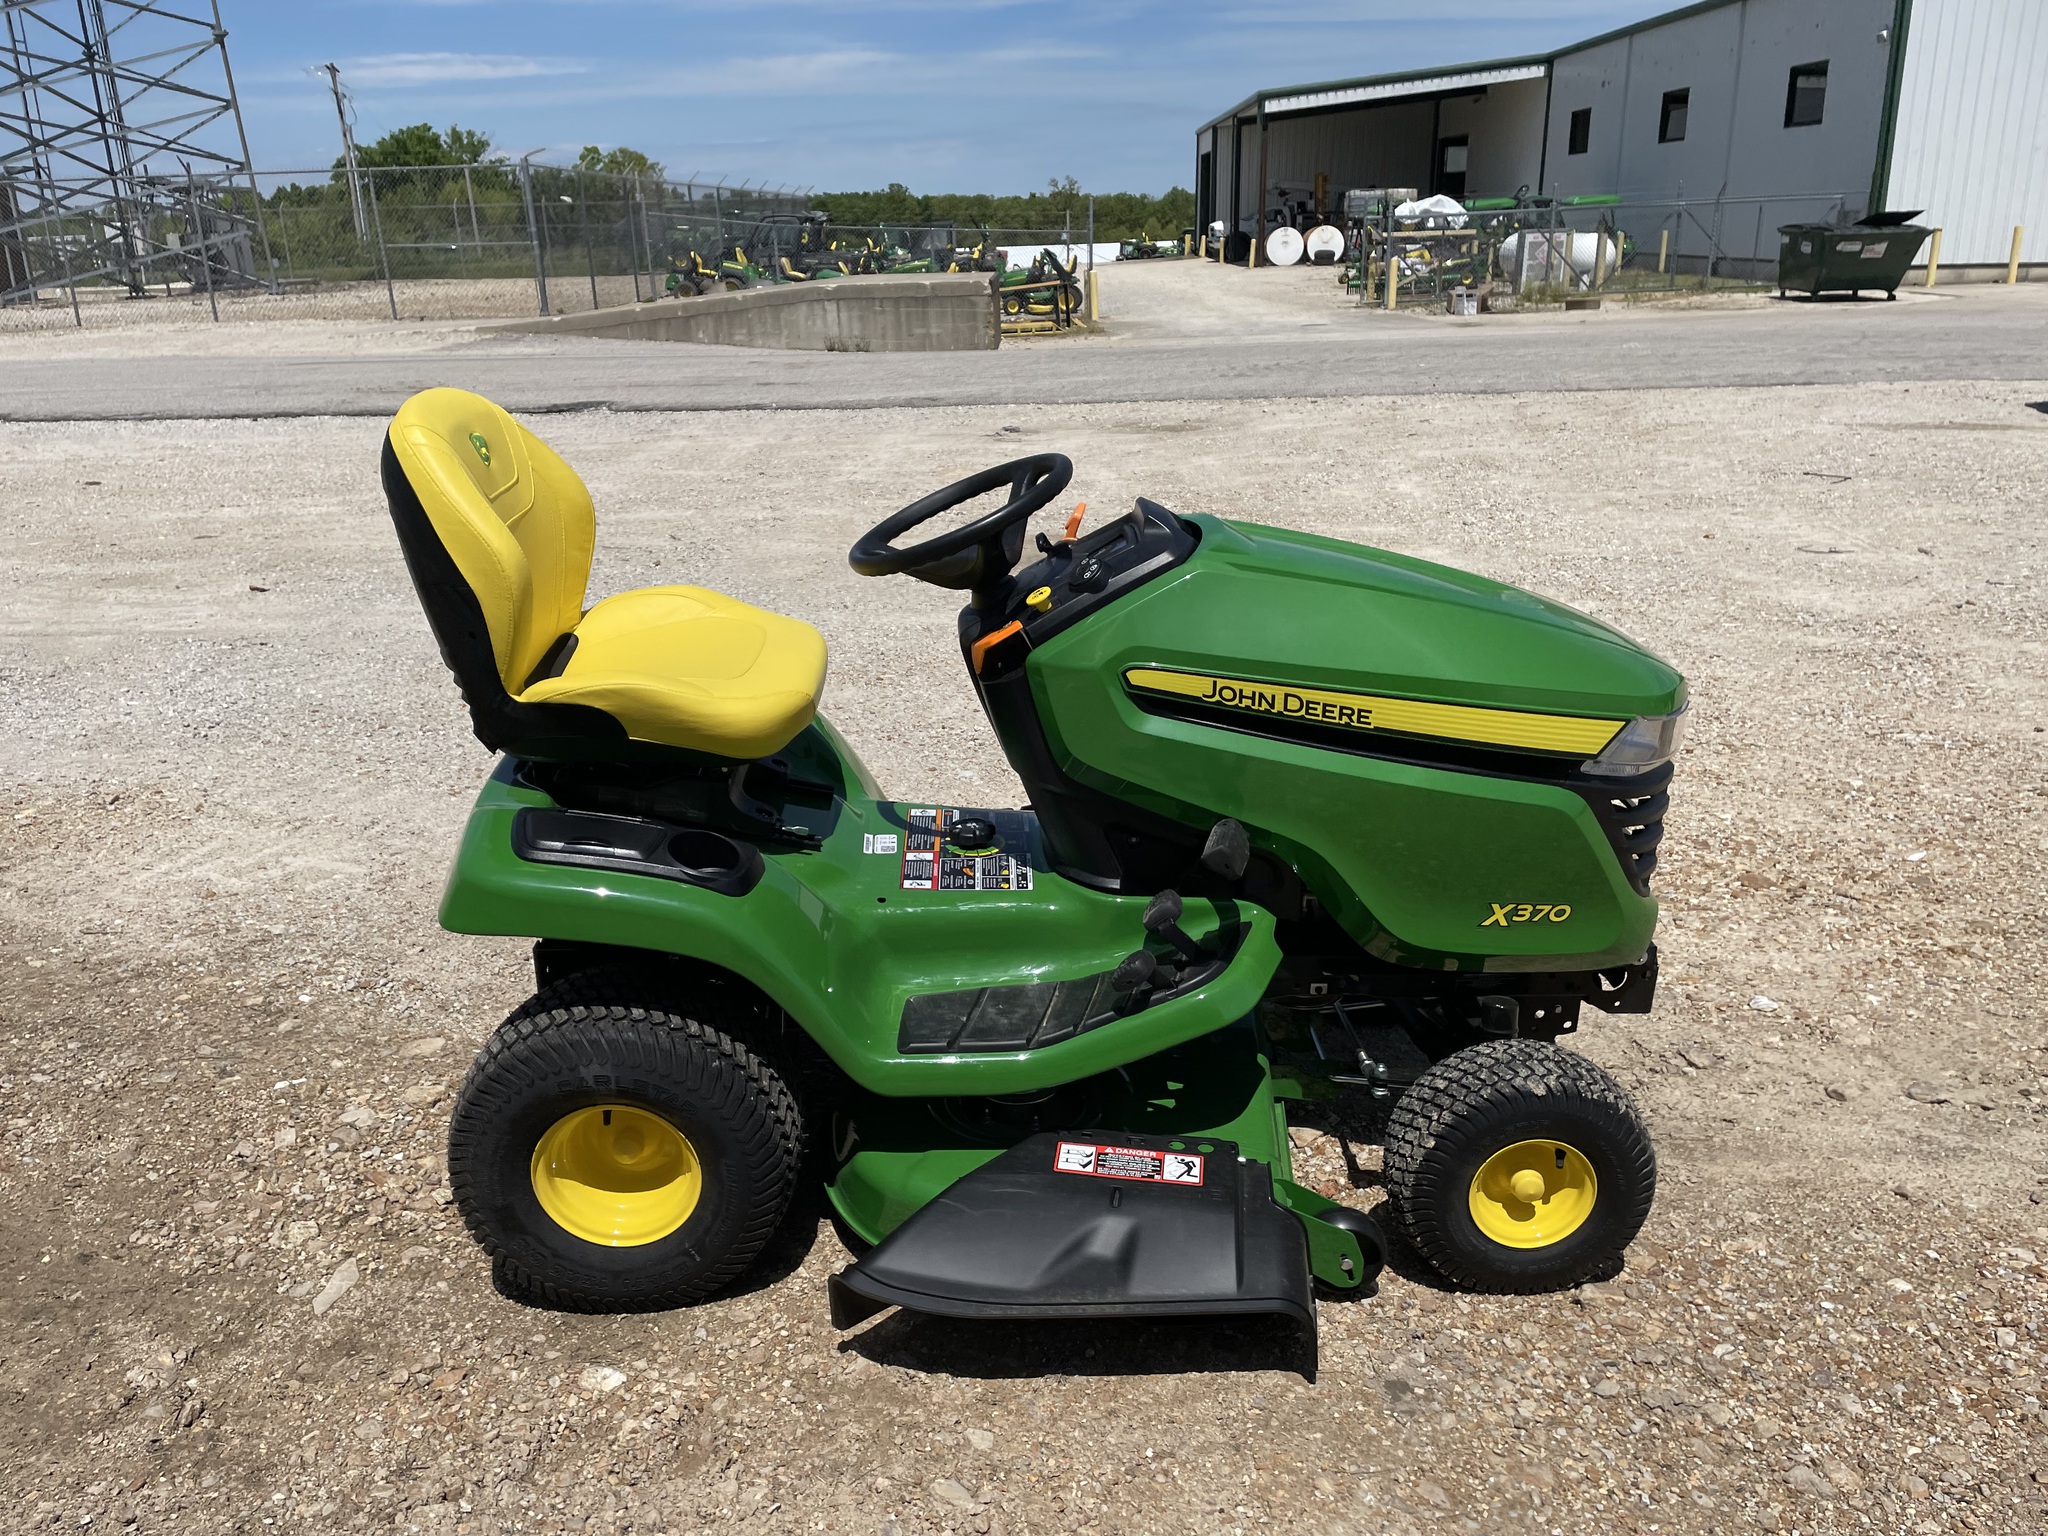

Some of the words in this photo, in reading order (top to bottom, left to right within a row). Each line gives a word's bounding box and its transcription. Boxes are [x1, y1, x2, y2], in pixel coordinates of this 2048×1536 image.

[1202, 680, 1276, 711] JOHN
[1283, 692, 1374, 727] DEERE
[1478, 903, 1572, 926] X370
[556, 1074, 698, 1115] CARLSTAR
[1115, 1147, 1157, 1157] DANGER
